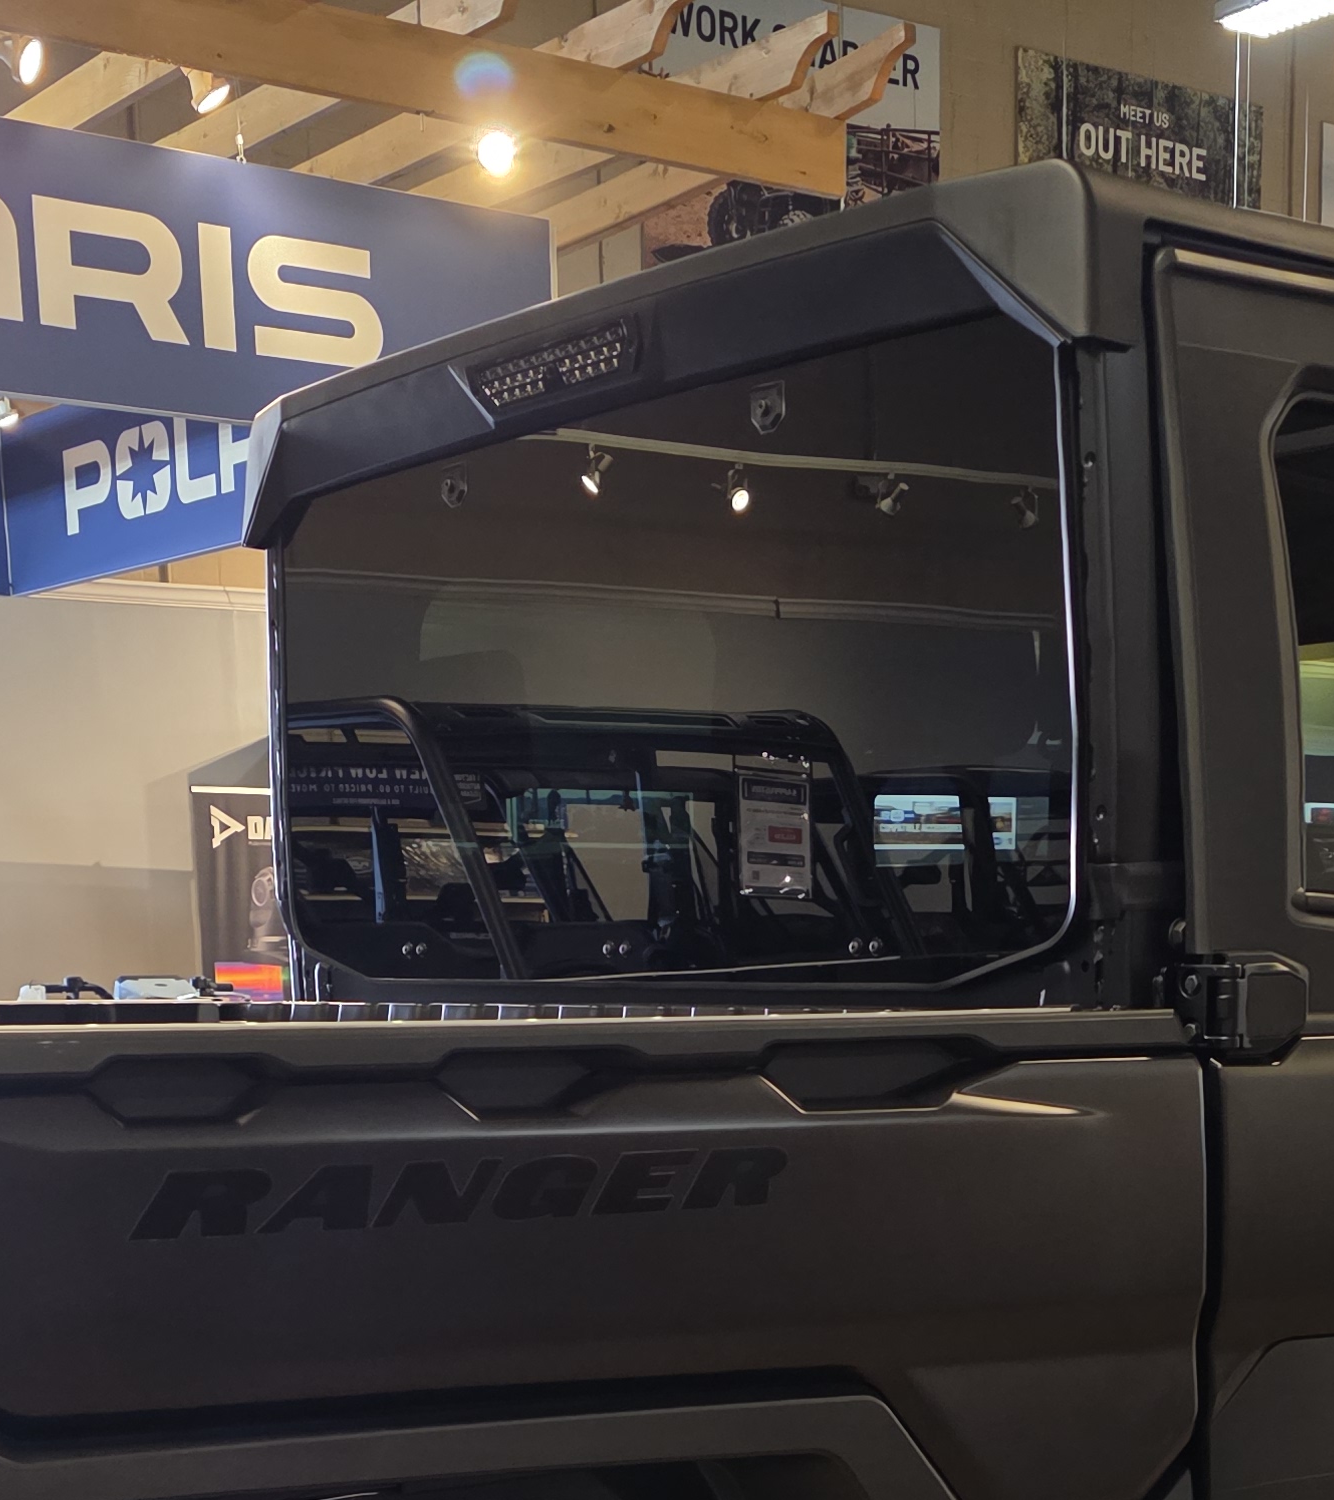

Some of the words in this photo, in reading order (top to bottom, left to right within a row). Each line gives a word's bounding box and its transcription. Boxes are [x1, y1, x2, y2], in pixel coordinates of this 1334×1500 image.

[1120, 103, 1151, 125] MEET
[1153, 111, 1170, 129] US
[1079, 122, 1132, 164] OUT
[1140, 135, 1207, 182] HERE
[128, 1144, 789, 1241] RANGER
